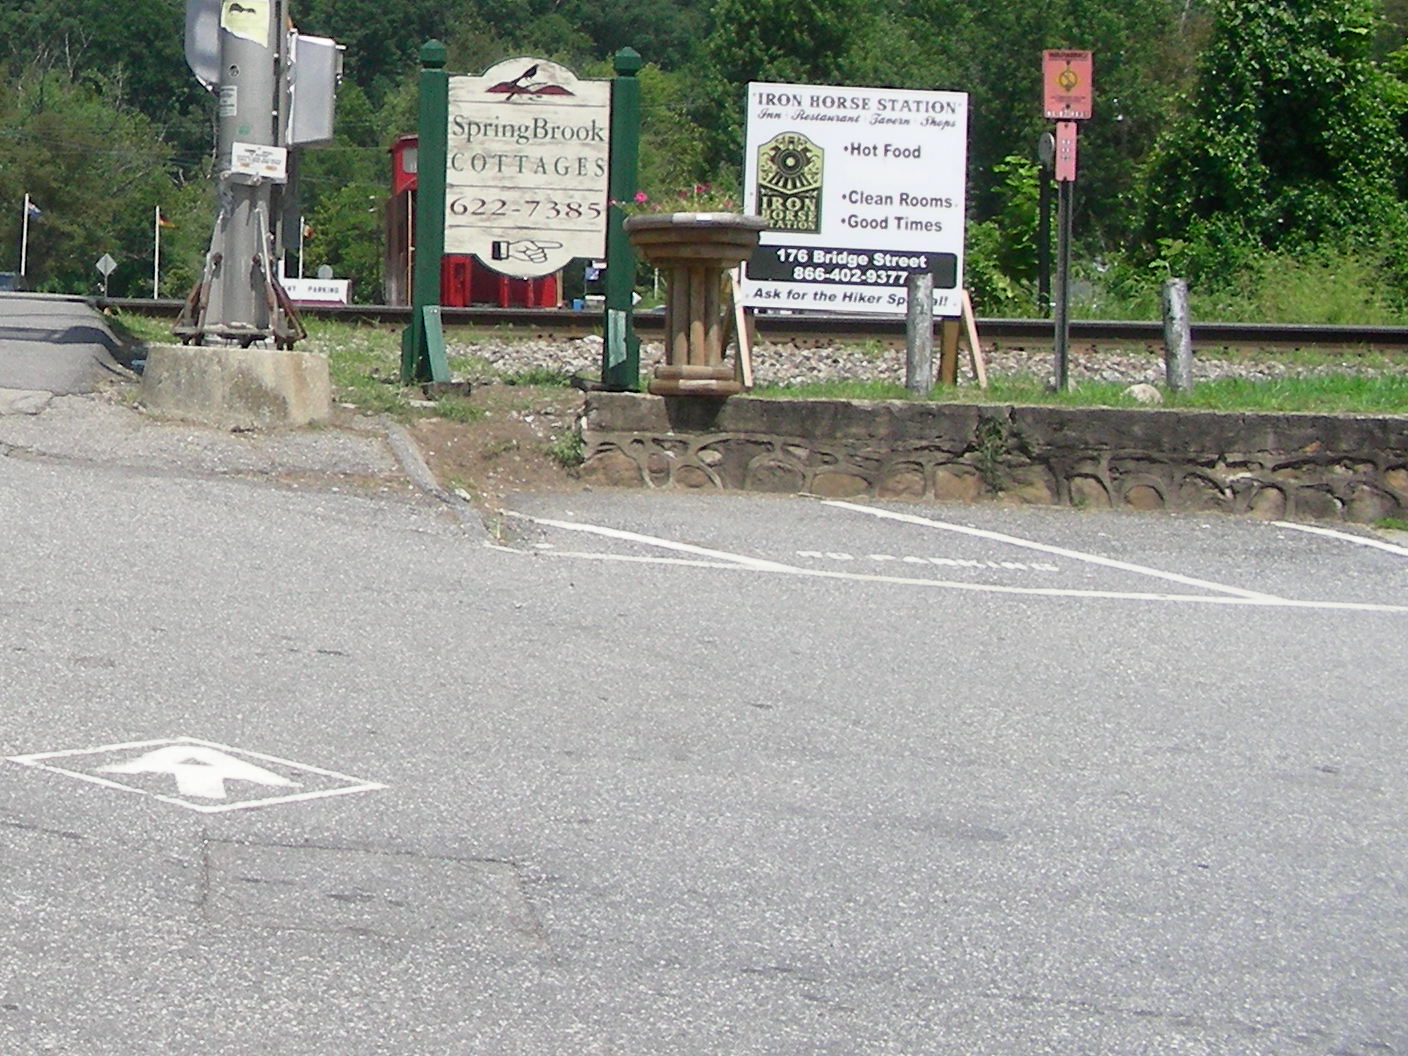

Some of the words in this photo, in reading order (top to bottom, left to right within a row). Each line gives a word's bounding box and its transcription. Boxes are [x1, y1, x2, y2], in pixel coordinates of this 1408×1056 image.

[758, 92, 802, 106] IRON
[810, 95, 870, 110] HORSE
[877, 98, 956, 114] STATION
[758, 108, 782, 119] Inn
[791, 109, 860, 122] Restaurant
[869, 113, 910, 125] Tavern
[920, 116, 956, 130] Shops
[452, 114, 605, 145] SpringBrook
[850, 142, 878, 157] Hot
[883, 143, 921, 159] Food
[451, 152, 605, 177] COTTAGES
[449, 196, 602, 220] 622-7385
[762, 196, 817, 211] IRON
[848, 190, 893, 206] Clean
[899, 192, 953, 209] Rooms
[768, 220, 815, 230] TATION
[847, 214, 889, 230] Good
[894, 216, 943, 232] Times
[777, 249, 809, 263] 176
[813, 250, 869, 267] Bridge
[873, 252, 928, 268] Street
[793, 267, 910, 285] 866-402-9377
[753, 287, 781, 300] Ask
[786, 288, 808, 301] for
[813, 290, 837, 303] the
[842, 291, 882, 304] Hiker
